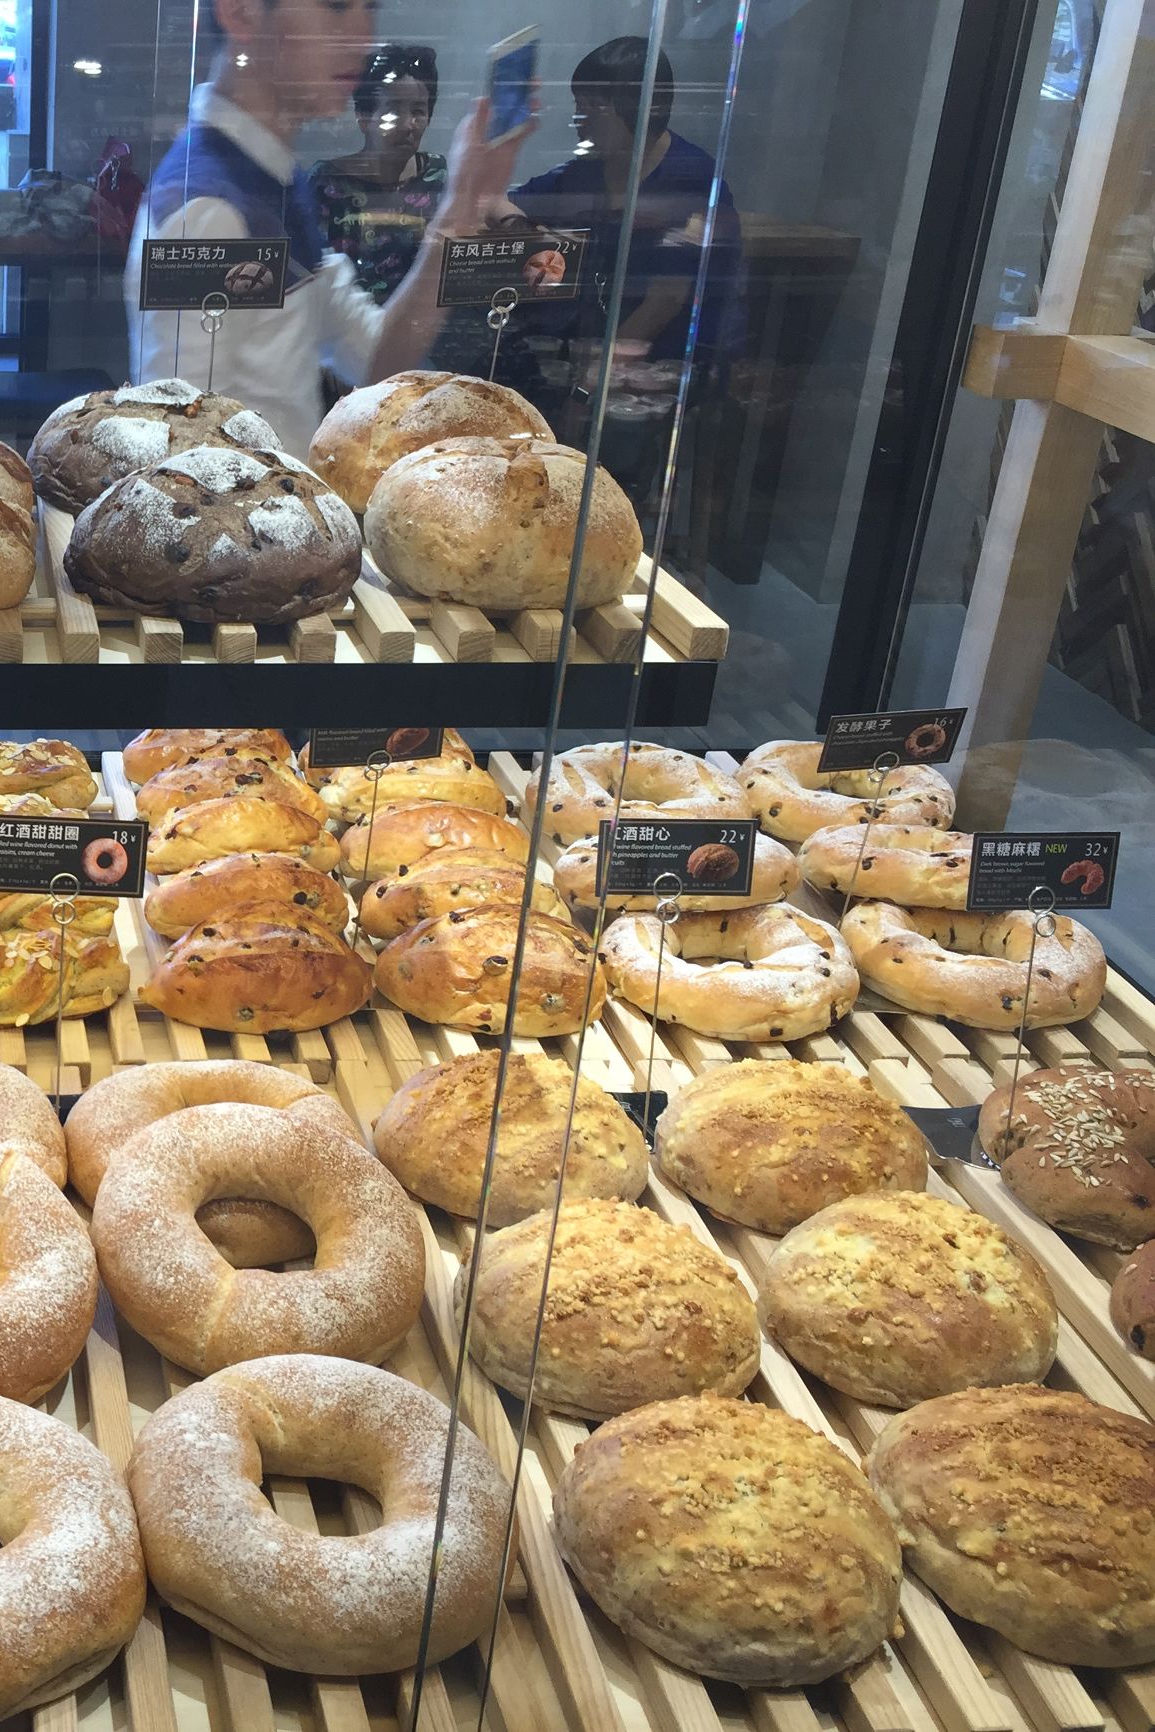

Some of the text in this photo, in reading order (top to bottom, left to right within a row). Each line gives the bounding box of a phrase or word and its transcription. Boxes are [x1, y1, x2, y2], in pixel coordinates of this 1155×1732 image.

[151, 246, 226, 261] 瑞士巧克力
[451, 241, 525, 258] 东风吉士堡
[835, 719, 892, 733] 发酵果子
[0, 822, 80, 842] 红酒甜甜圈
[24, 841, 47, 849] flavored
[982, 841, 1041, 857] 黑糖麻糬
[1045, 843, 1068, 854] NEW
